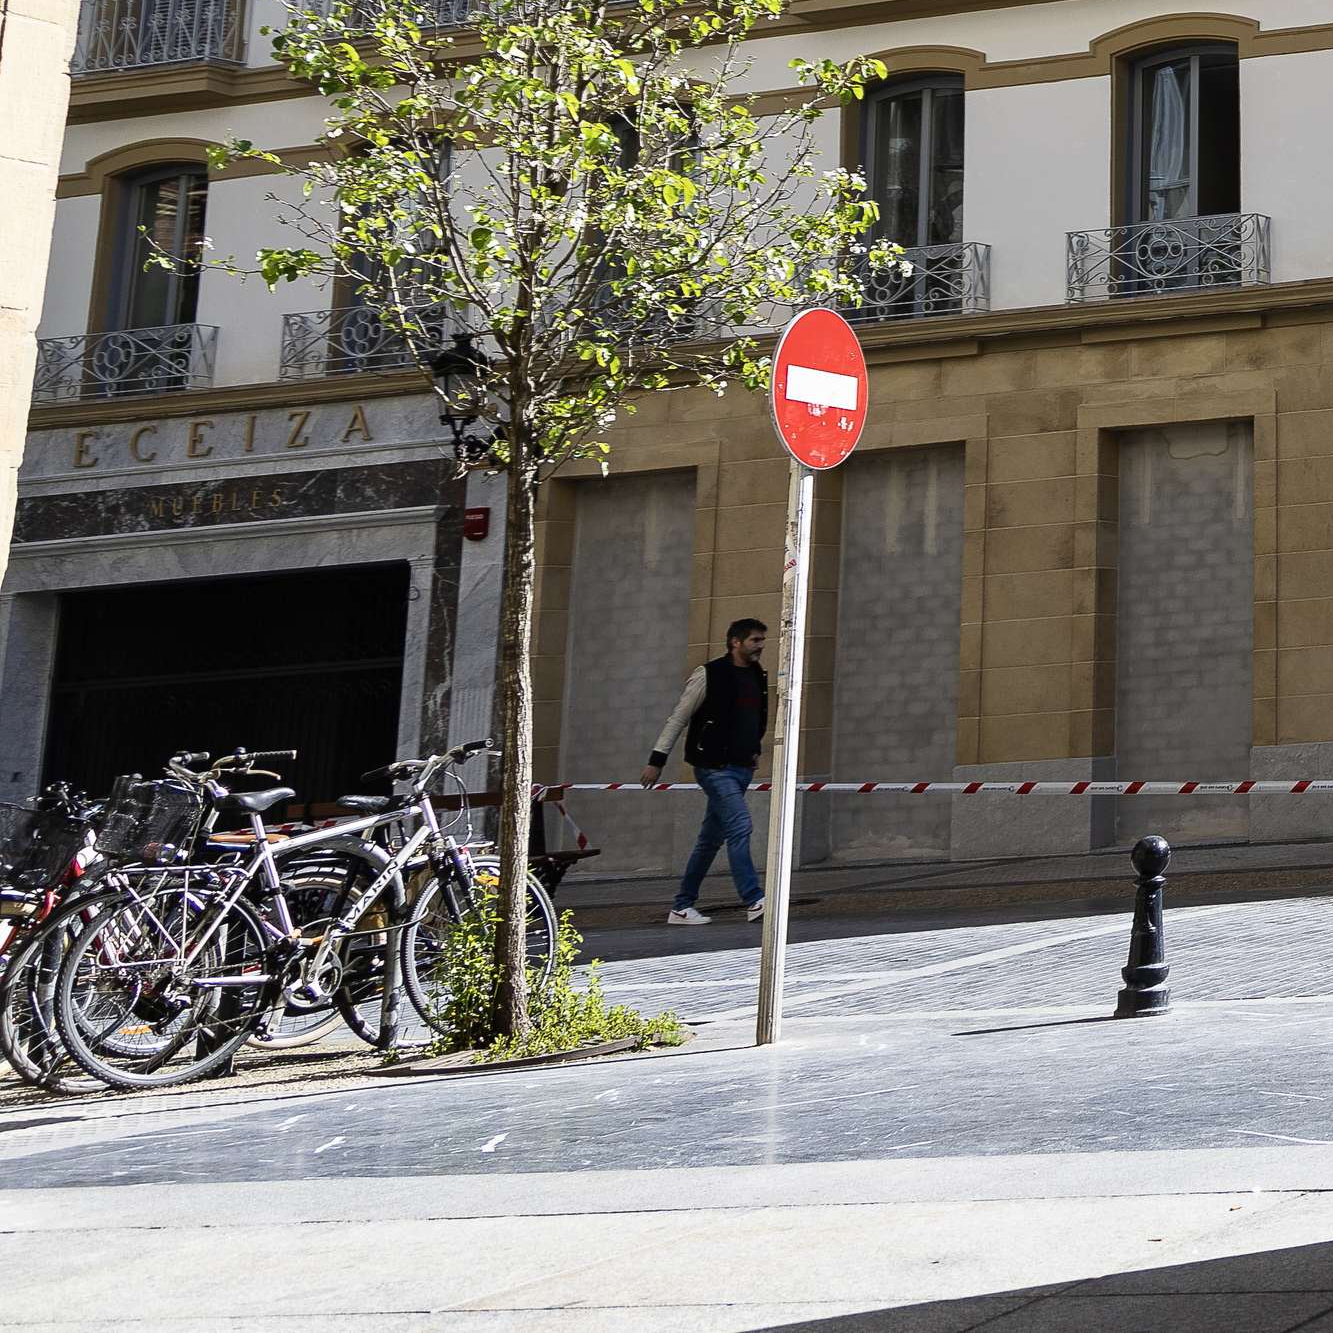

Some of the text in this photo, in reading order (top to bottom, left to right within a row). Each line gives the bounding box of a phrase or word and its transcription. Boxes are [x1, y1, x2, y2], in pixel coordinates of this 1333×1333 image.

[72, 405, 374, 469] ECEIZA
[148, 489, 282, 517] MUEBLES
[345, 861, 399, 923] MARIN
